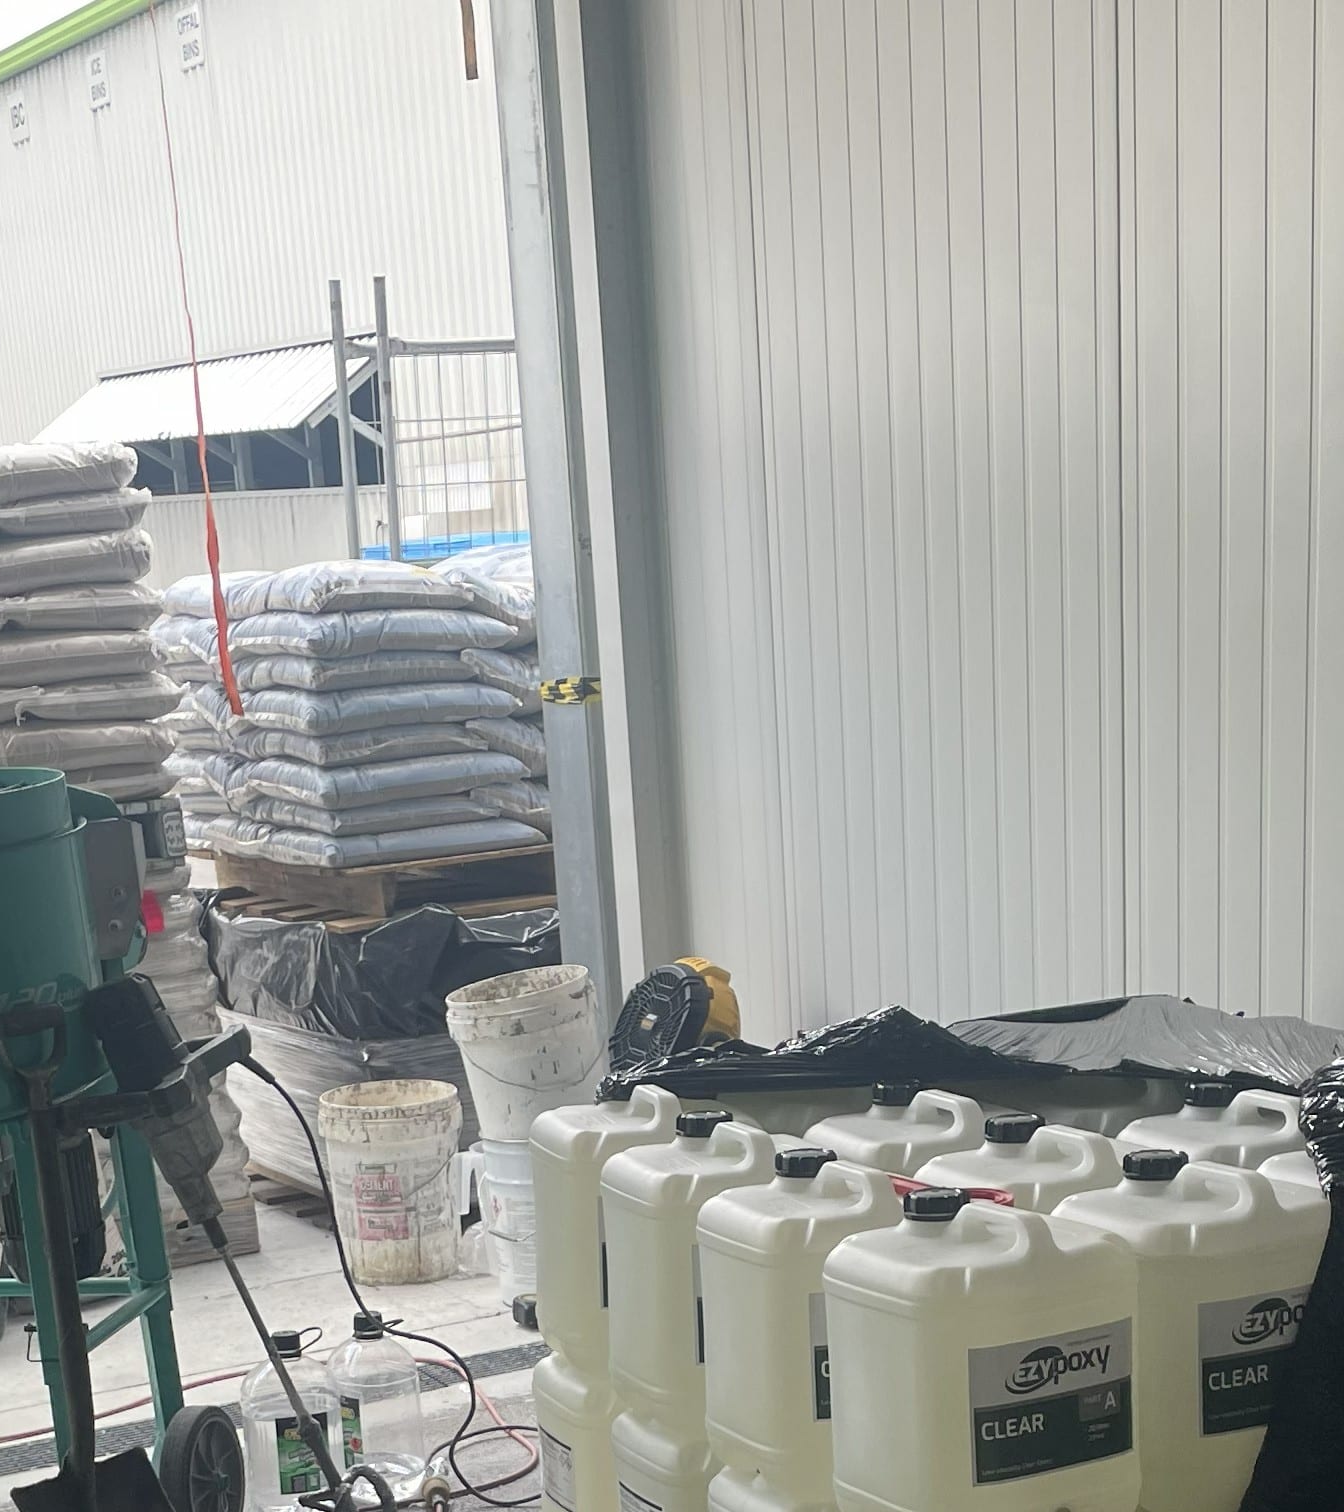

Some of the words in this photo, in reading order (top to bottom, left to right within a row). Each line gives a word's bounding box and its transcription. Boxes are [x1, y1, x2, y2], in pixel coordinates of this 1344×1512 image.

[10, 102, 26, 129] IBC
[1013, 1344, 1111, 1385] EZYpoxy
[1208, 1363, 1269, 1391] CLEAR
[1104, 1391, 1116, 1410] A
[981, 1413, 1044, 1441] CLEAR
